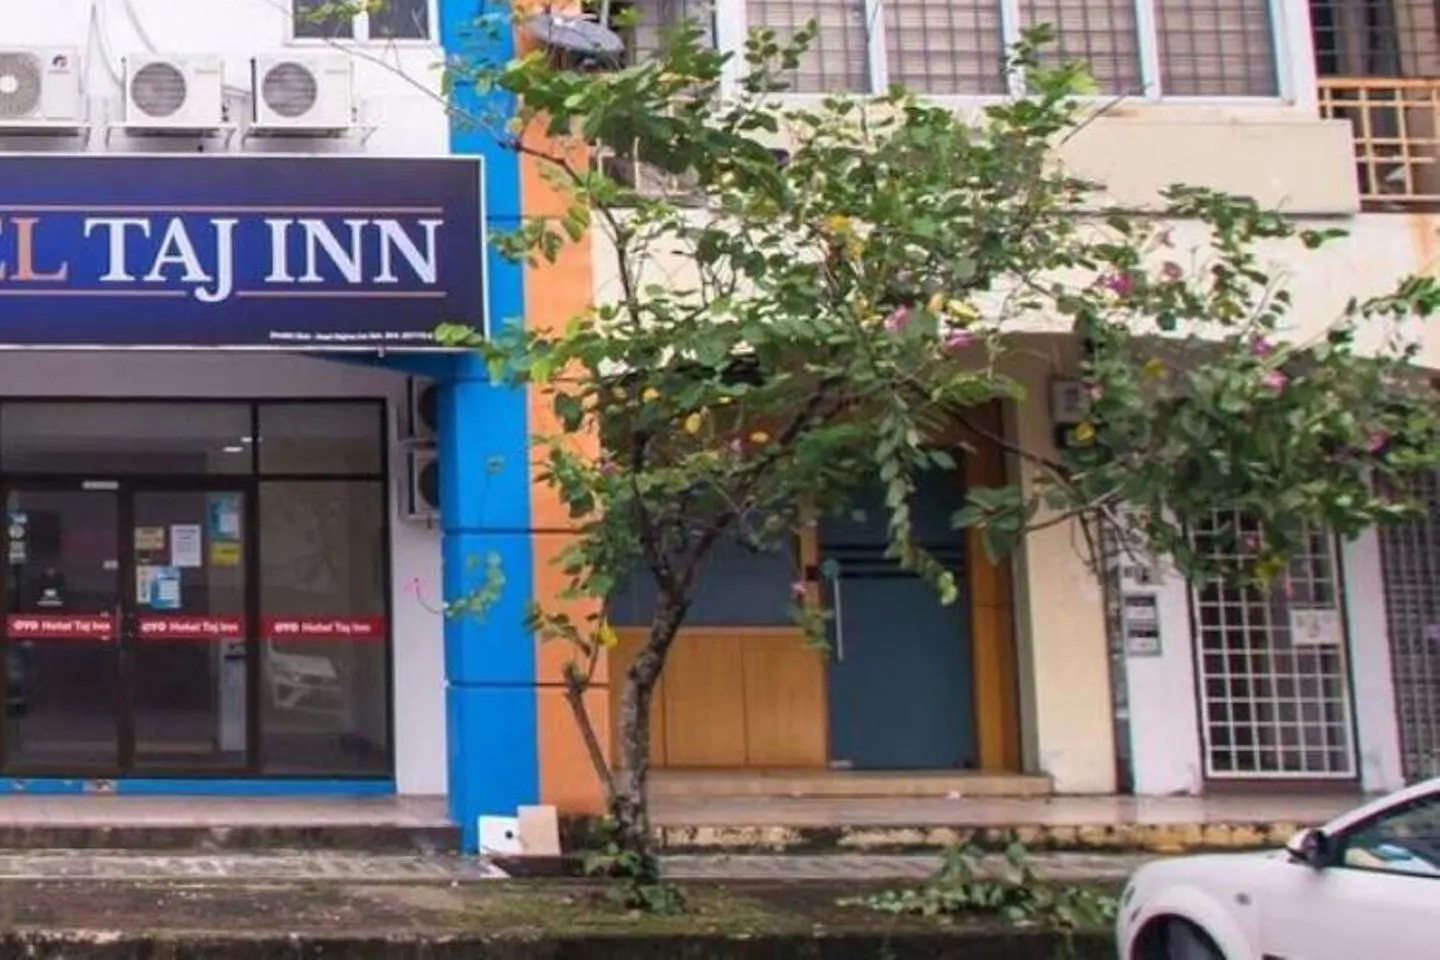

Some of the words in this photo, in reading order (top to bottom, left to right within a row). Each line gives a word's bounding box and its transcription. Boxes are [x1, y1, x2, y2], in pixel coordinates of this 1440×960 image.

[84, 217, 238, 302] TAJ
[264, 219, 444, 284] INN
[42, 619, 72, 630] Hotel
[75, 619, 90, 632] Taj
[169, 621, 201, 631] Hotel
[203, 621, 218, 633] Taj
[302, 621, 332, 632] Hotel
[335, 621, 350, 634] Taj
